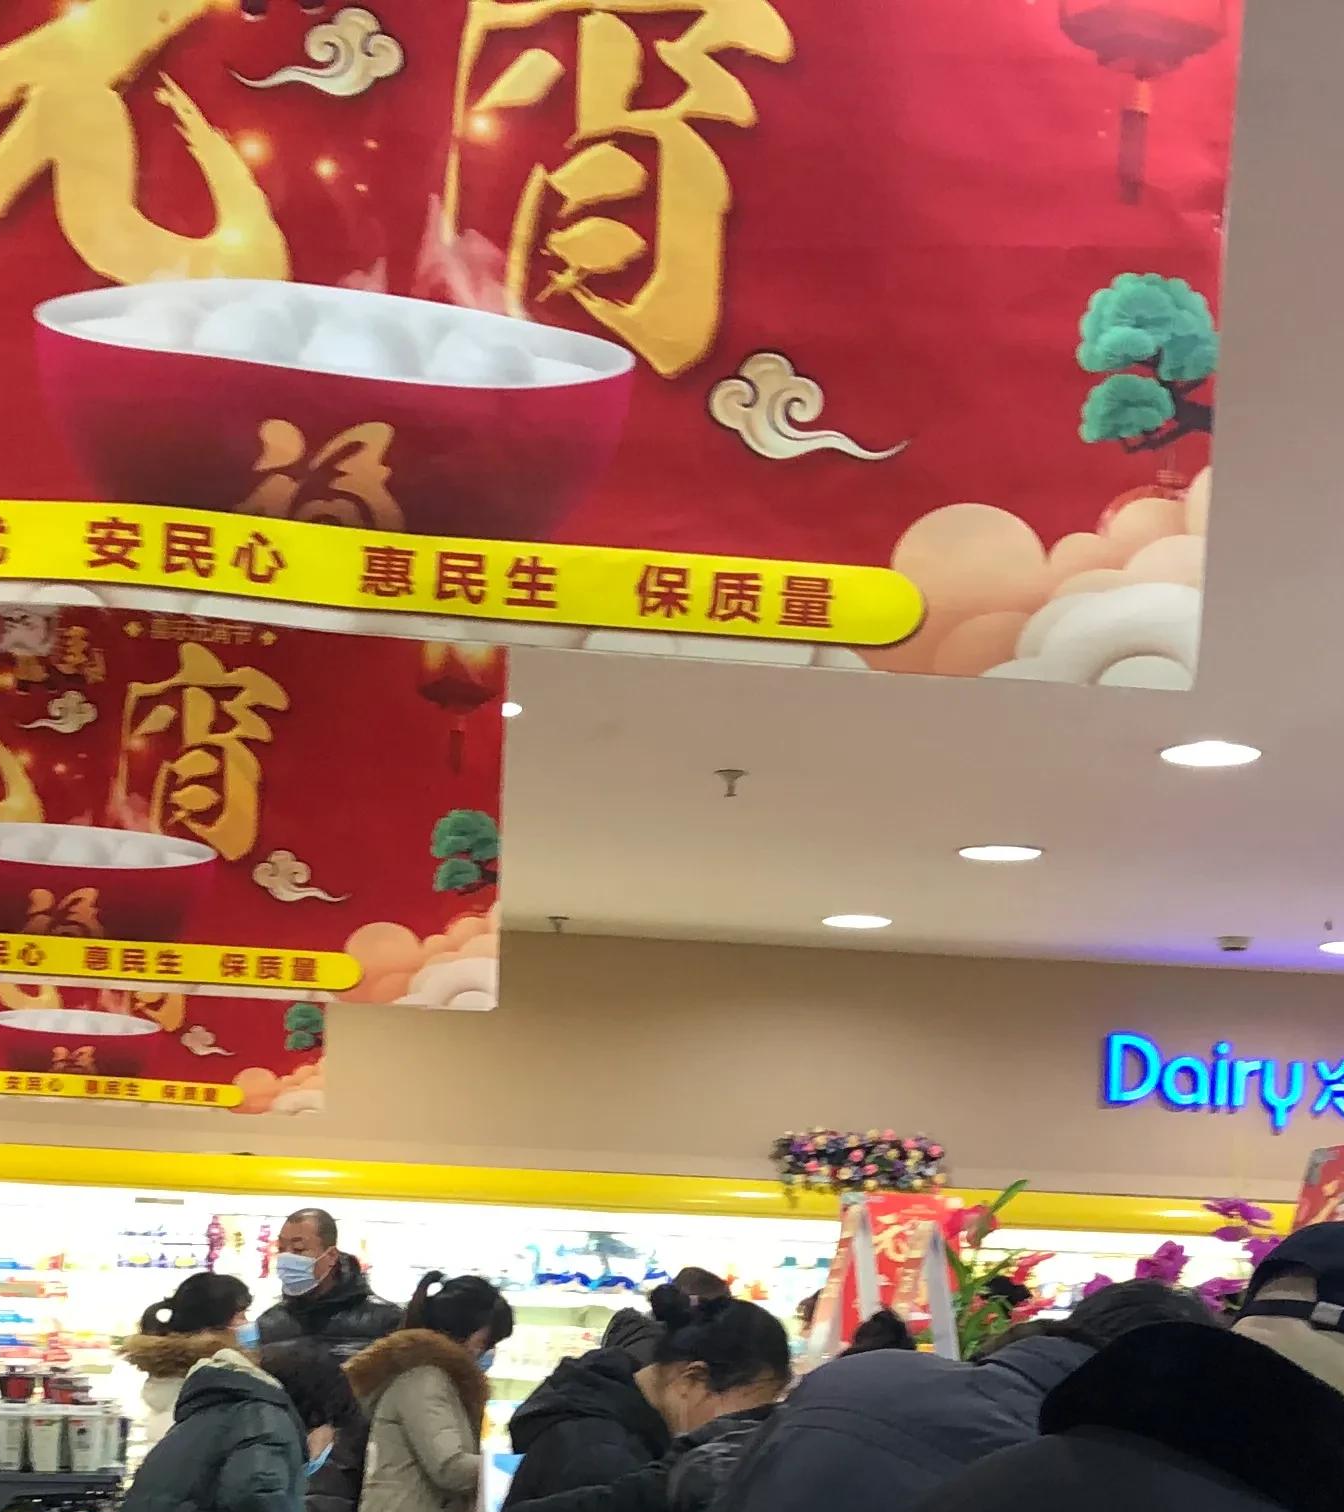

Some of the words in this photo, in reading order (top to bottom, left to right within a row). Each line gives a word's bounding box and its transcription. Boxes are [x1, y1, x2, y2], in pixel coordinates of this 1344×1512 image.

[86, 516, 288, 585] 安民心
[359, 543, 561, 608] 惠民生
[635, 563, 839, 632] 保质量
[82, 945, 184, 977] 惠民生
[219, 952, 320, 984] 保质量
[1106, 1032, 1305, 1130] Dairy
